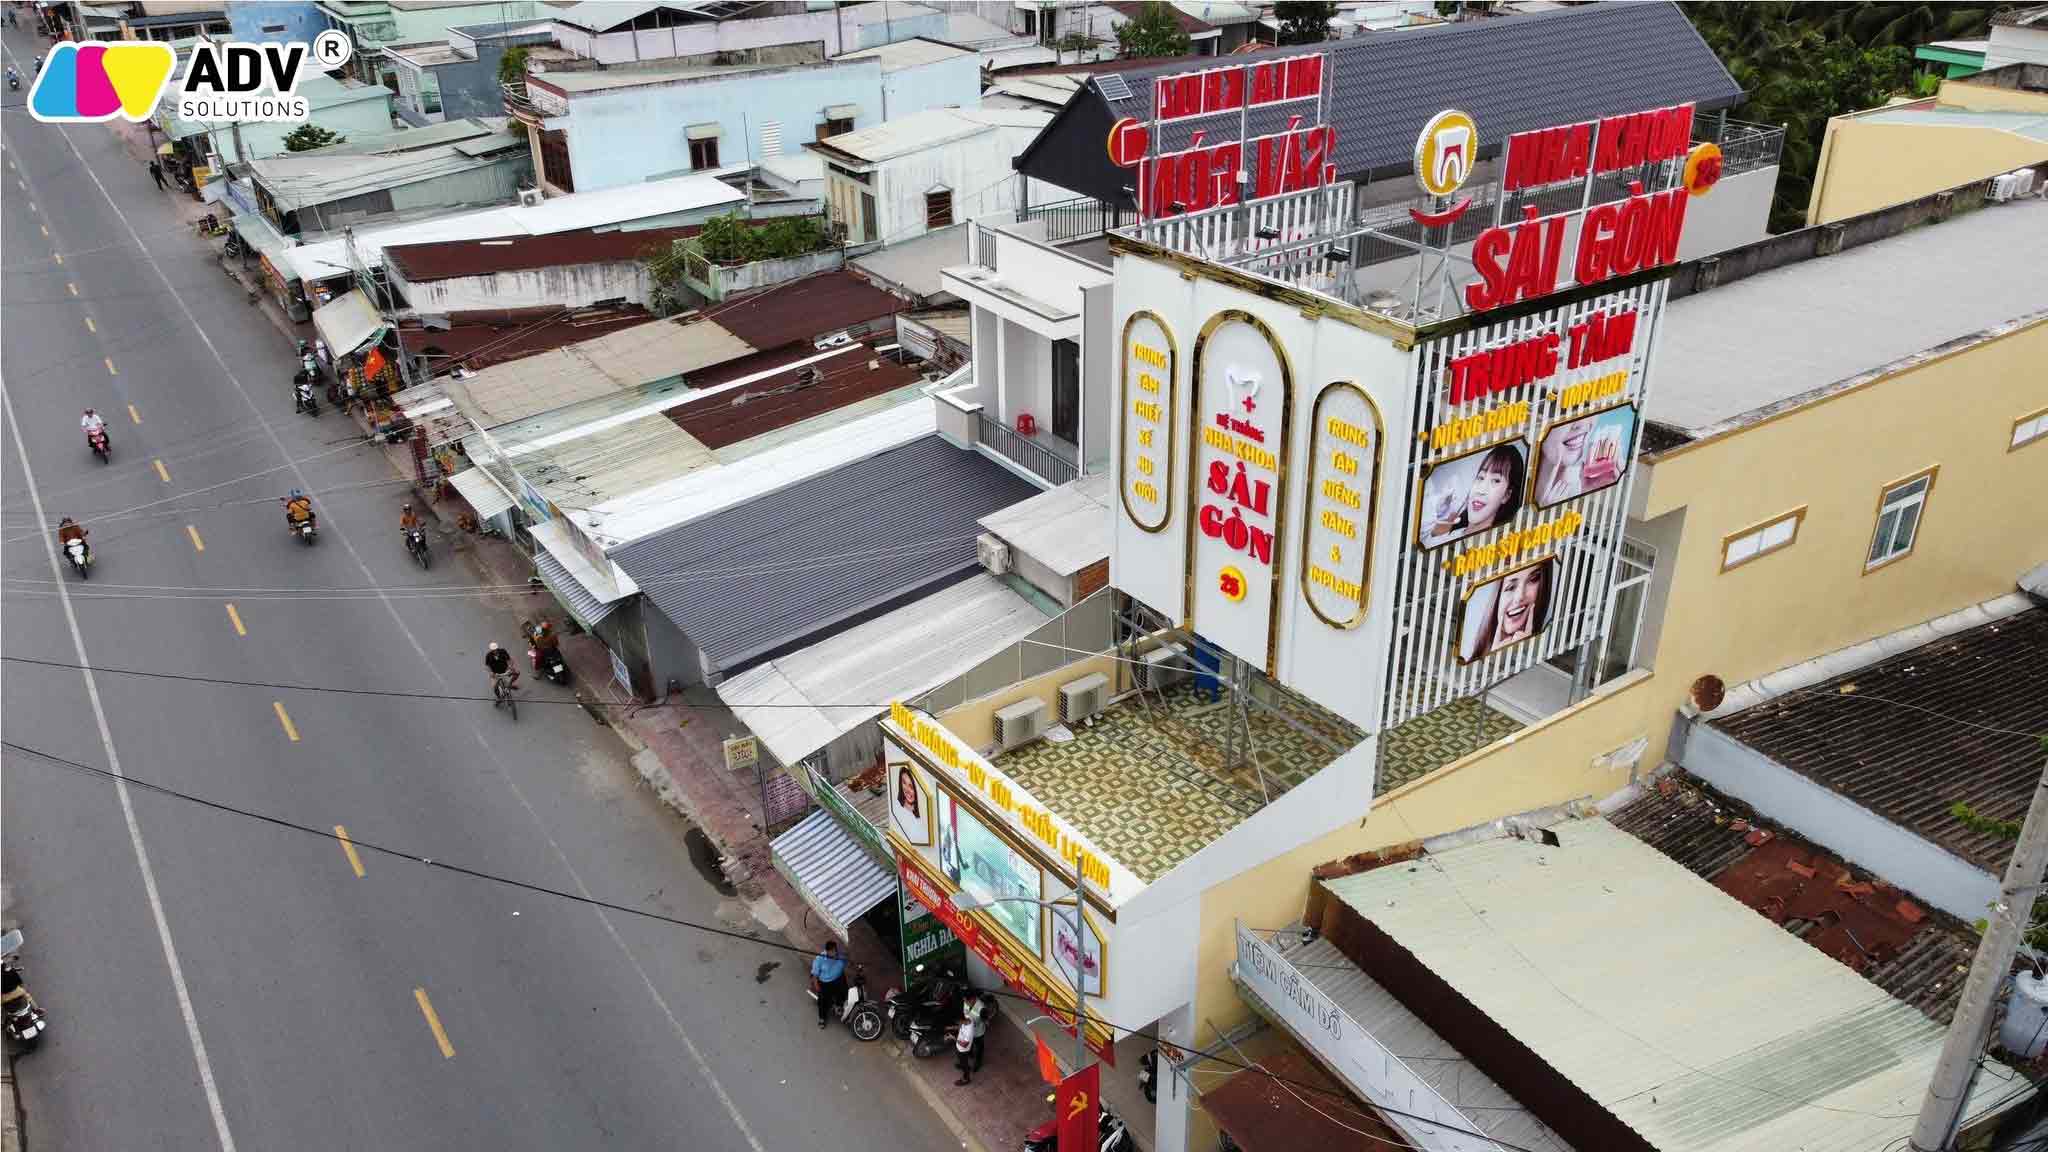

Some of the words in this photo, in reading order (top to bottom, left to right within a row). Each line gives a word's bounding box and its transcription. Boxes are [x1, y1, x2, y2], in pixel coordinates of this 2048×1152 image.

[1593, 103, 1695, 175] KHOA
[1465, 204, 1568, 311] SÀI
[1574, 180, 1689, 285] GÒN
[1449, 331, 1561, 406] TRUNG
[1567, 309, 1638, 370] TÂM
[1561, 369, 1628, 409] IMPLANT
[1232, 440, 1277, 472] KHOA
[1207, 460, 1271, 517] SÀI
[1200, 504, 1274, 565] GÒN
[1309, 564, 1362, 602] IMPLANT
